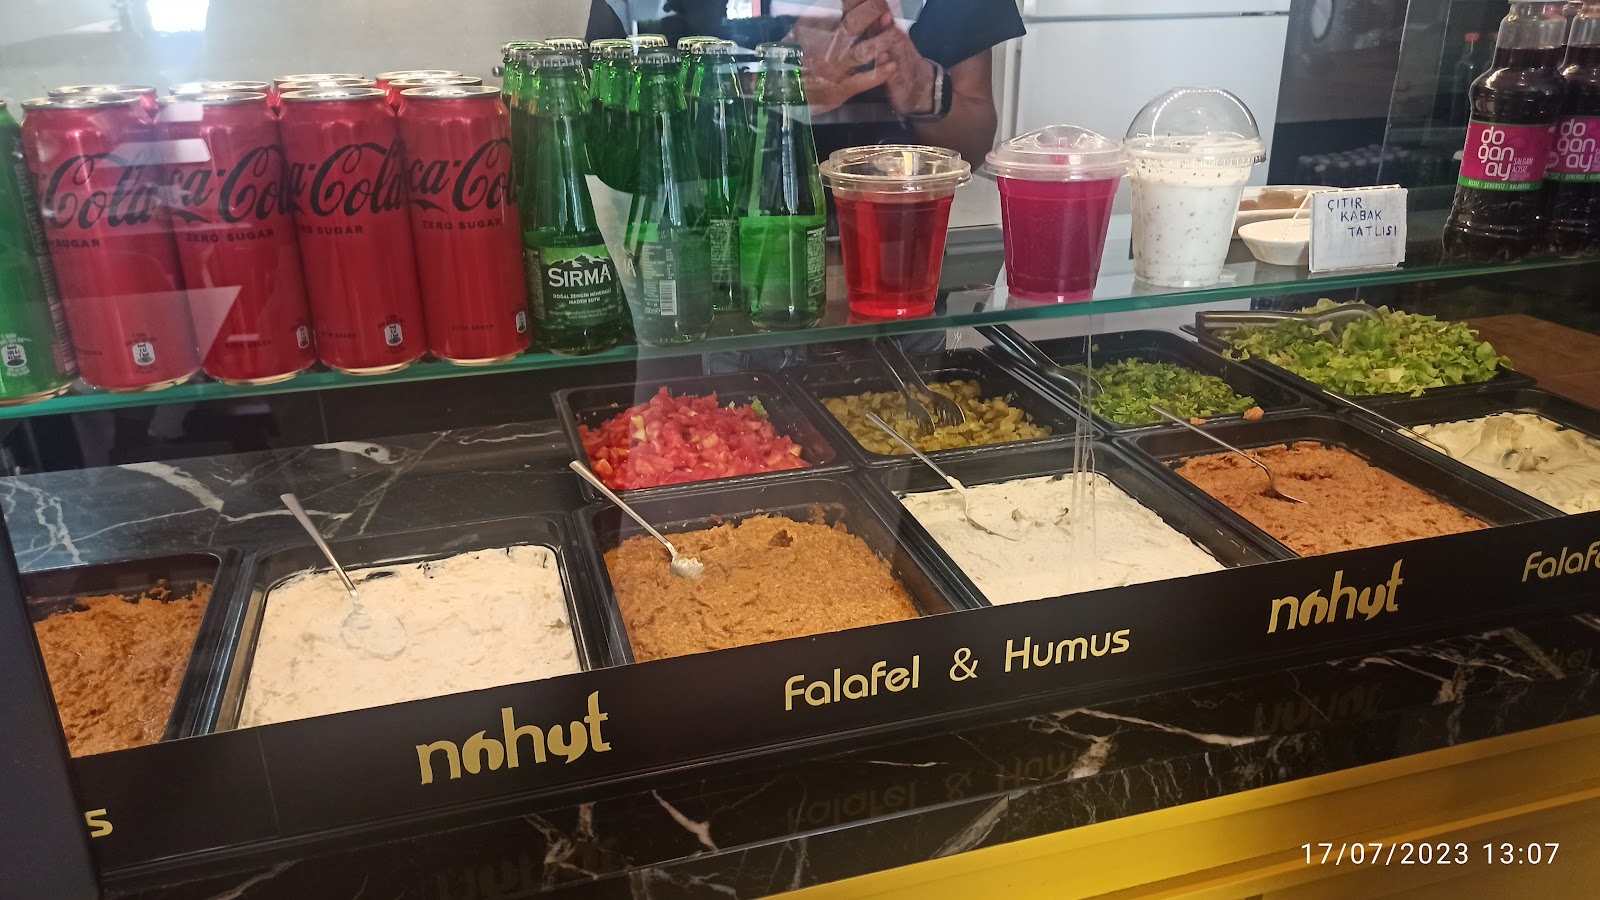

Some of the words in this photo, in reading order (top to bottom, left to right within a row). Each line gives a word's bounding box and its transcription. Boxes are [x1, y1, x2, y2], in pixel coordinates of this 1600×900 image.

[1340, 210, 1382, 222] KABAK
[317, 225, 363, 235] SUGAR
[423, 221, 453, 230] ZERO
[1348, 225, 1397, 237] TATLISI
[547, 263, 612, 288] SIRMA
[1267, 559, 1404, 634] nohut
[949, 647, 979, 682] &
[1004, 629, 1131, 672] Humus
[415, 690, 612, 786] nohut
